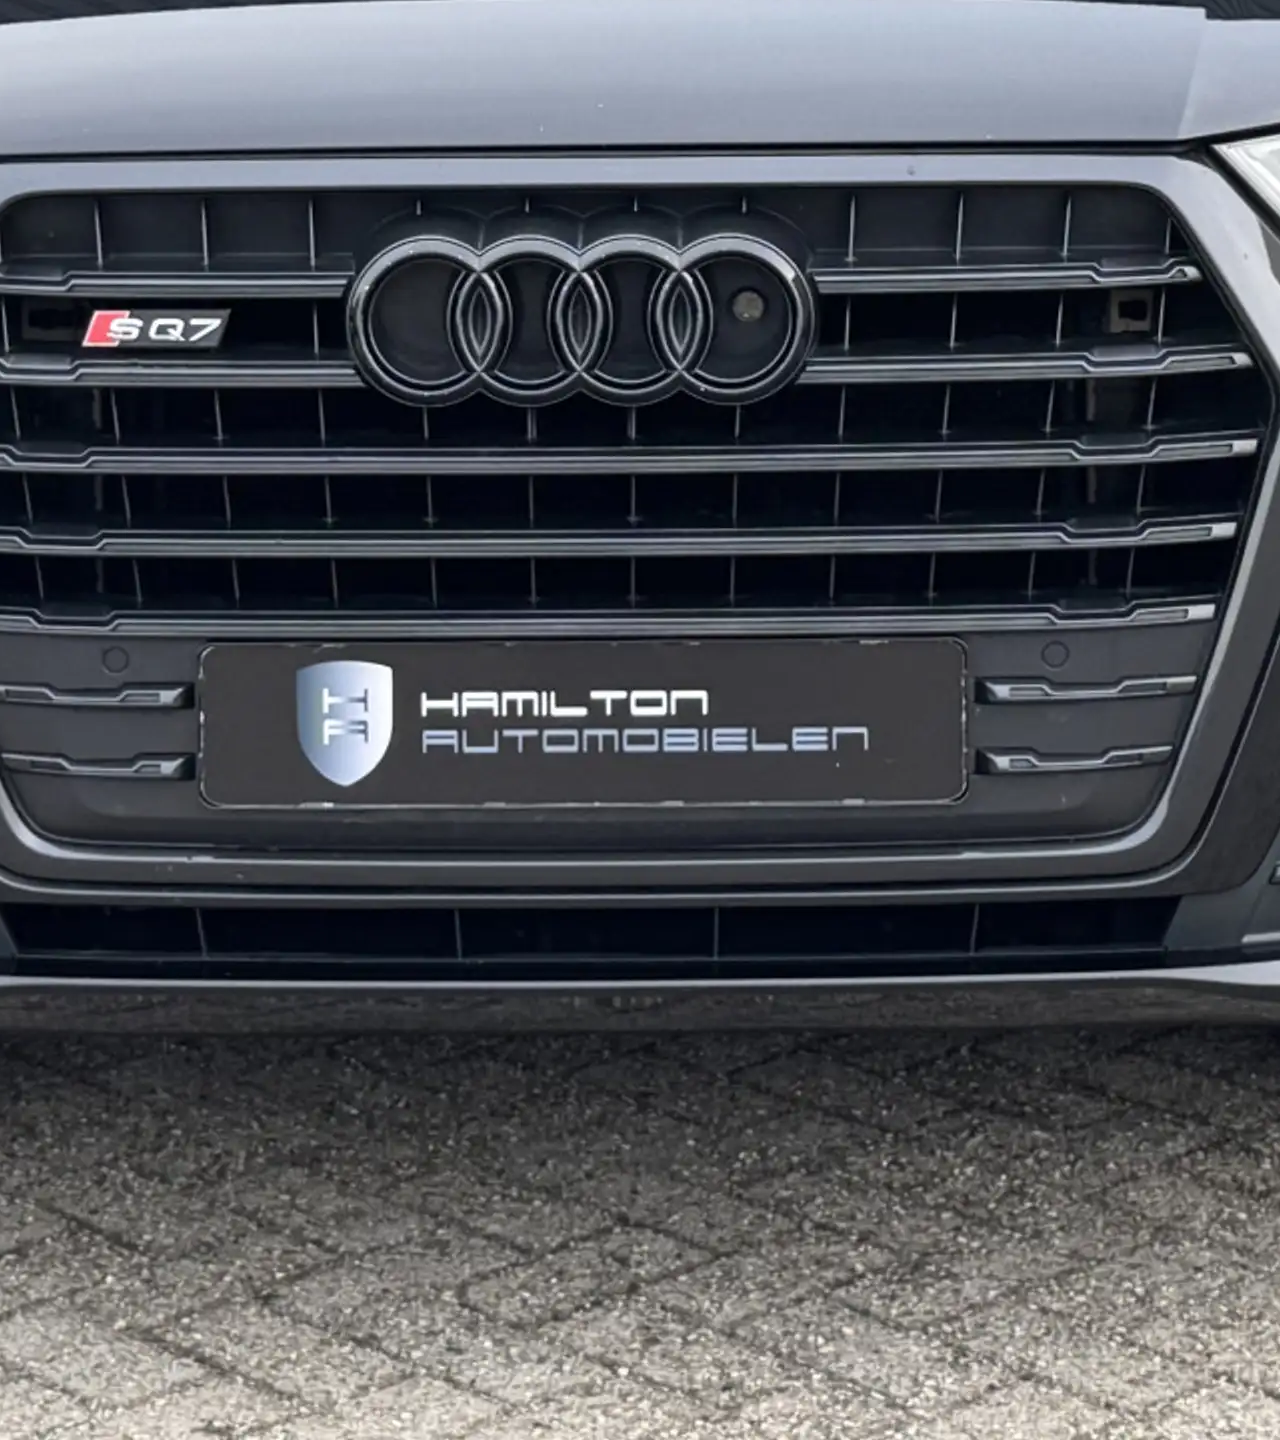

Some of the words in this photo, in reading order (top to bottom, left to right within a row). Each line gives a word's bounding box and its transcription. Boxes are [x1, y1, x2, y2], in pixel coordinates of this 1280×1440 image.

[106, 318, 223, 342] SQ7
[420, 689, 710, 718] HAMILTON
[421, 726, 870, 755] AUTOMOBIELEN
